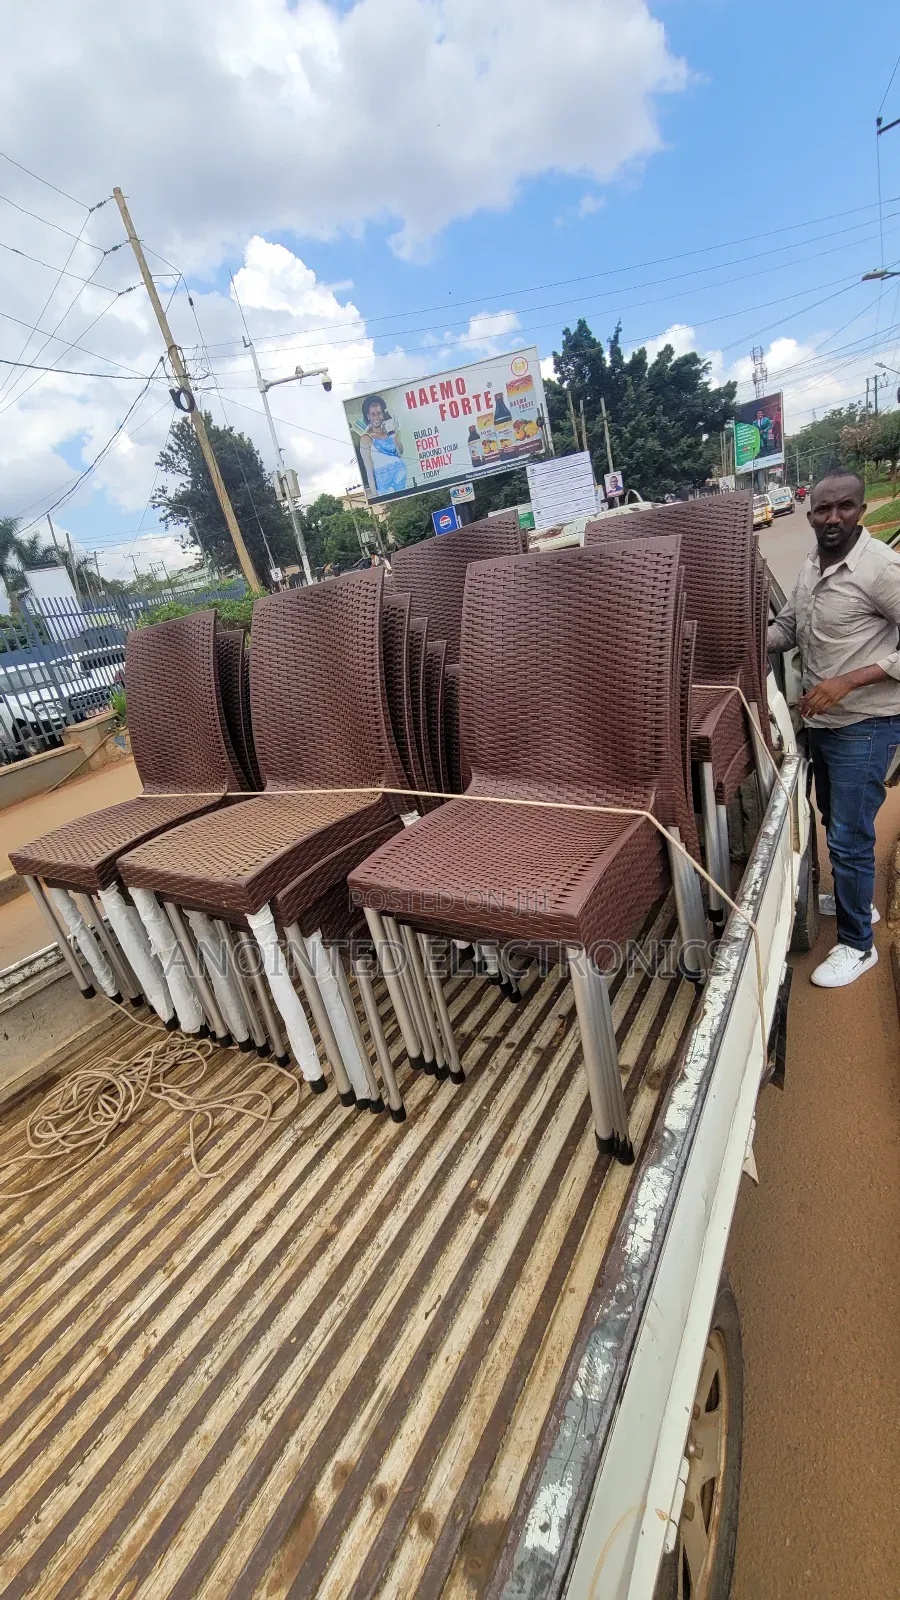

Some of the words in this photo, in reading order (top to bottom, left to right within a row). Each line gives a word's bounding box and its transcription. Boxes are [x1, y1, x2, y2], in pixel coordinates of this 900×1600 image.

[405, 378, 466, 409] HAEMO
[439, 391, 493, 422] FORTE
[414, 428, 433, 440] BUILD
[435, 426, 439, 434] A
[416, 435, 440, 452] FORT
[418, 447, 442, 460] AROUND
[442, 443, 459, 453] YOUR
[420, 453, 452, 472] FAMILY
[422, 469, 441, 479] TODAY
